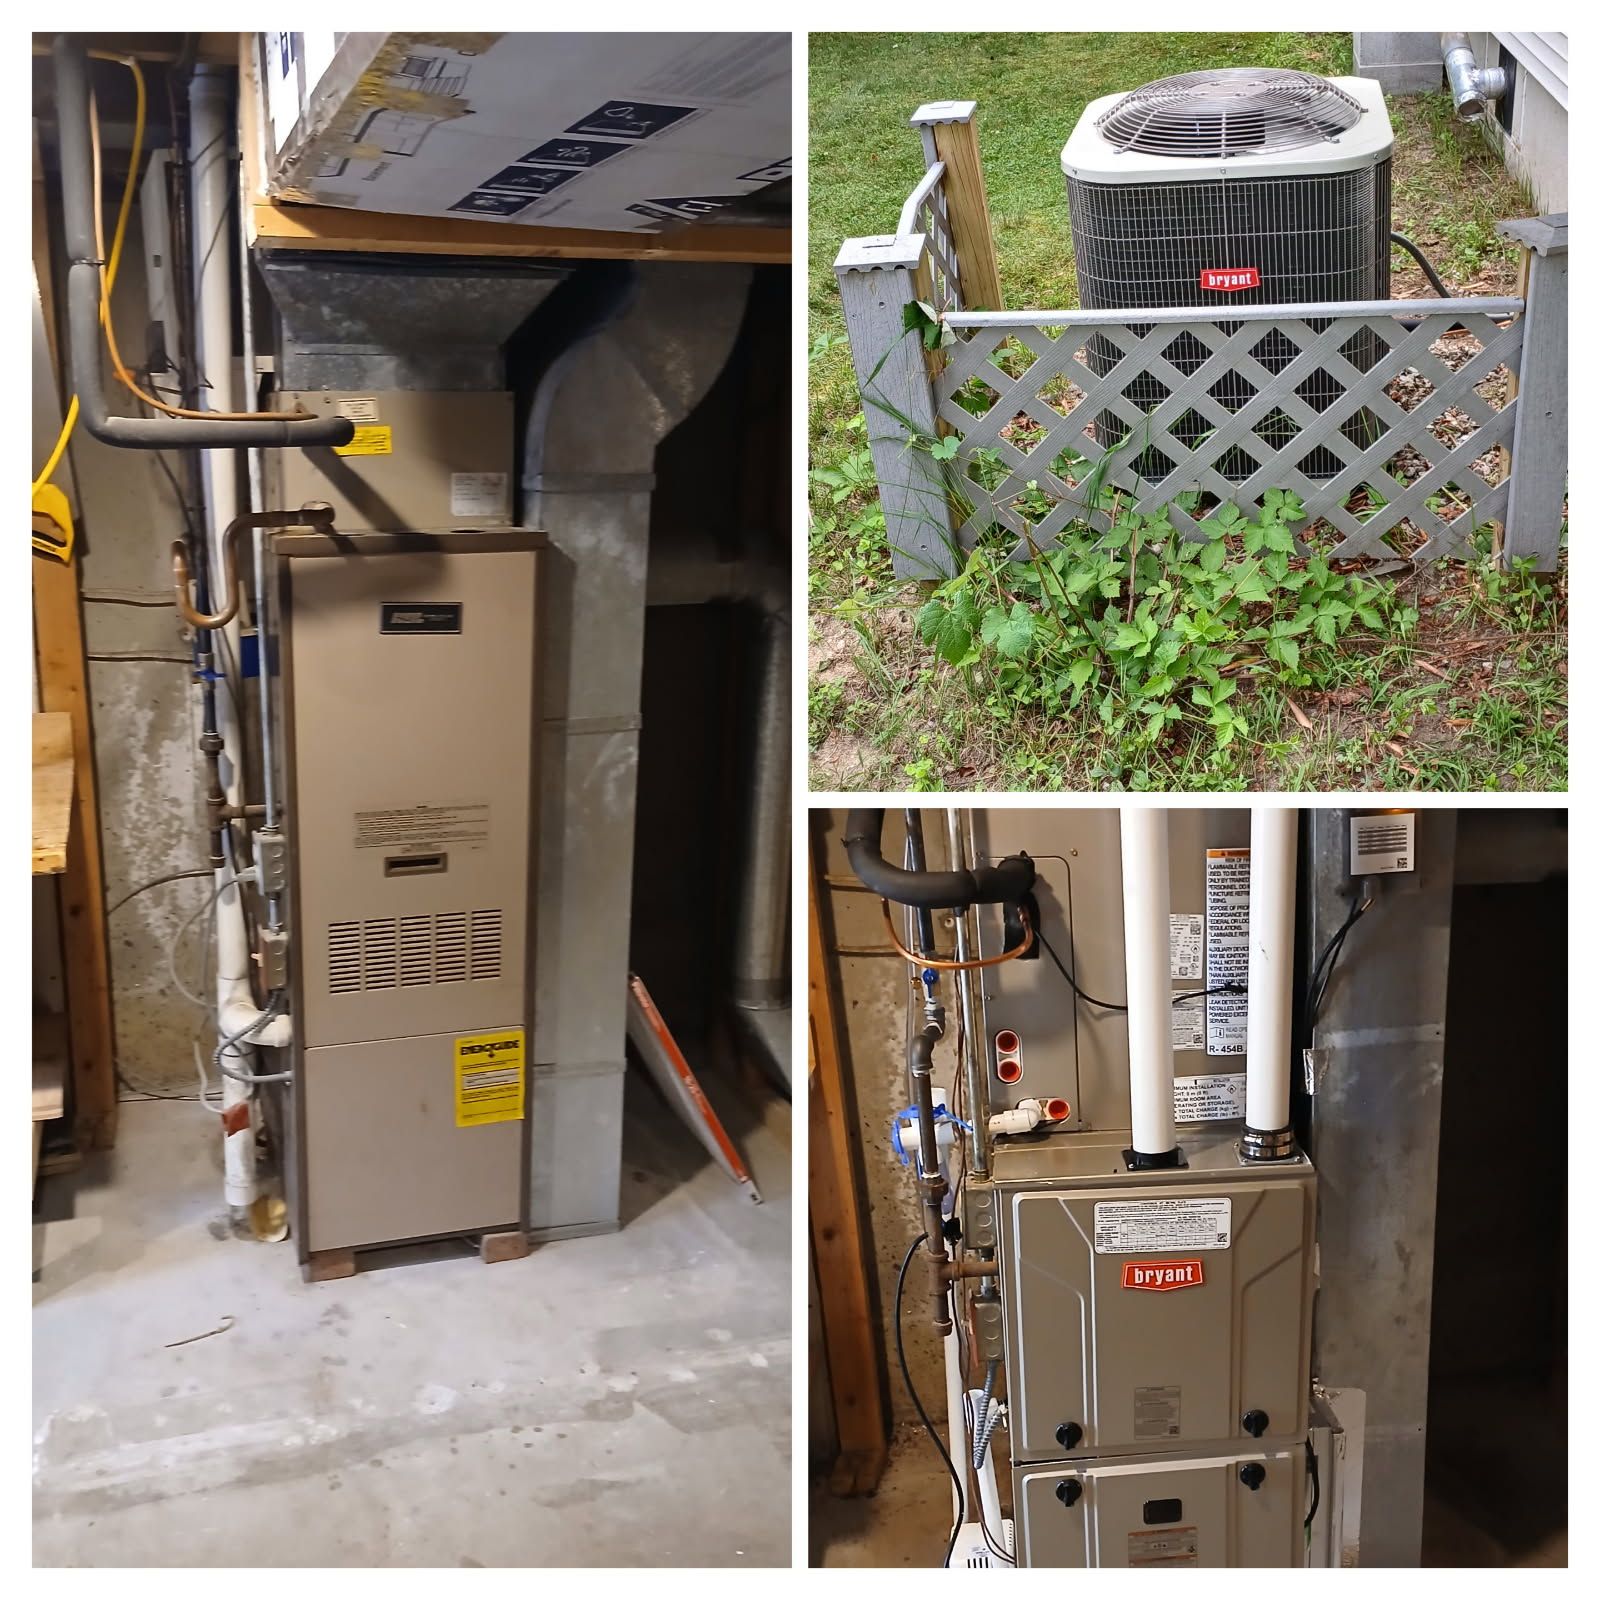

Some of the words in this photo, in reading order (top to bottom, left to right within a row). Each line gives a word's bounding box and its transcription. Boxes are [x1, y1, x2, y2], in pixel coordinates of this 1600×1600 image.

[1208, 272, 1252, 288] bryant
[1220, 1044, 1243, 1053] 454B
[1134, 1265, 1193, 1286] bryant
